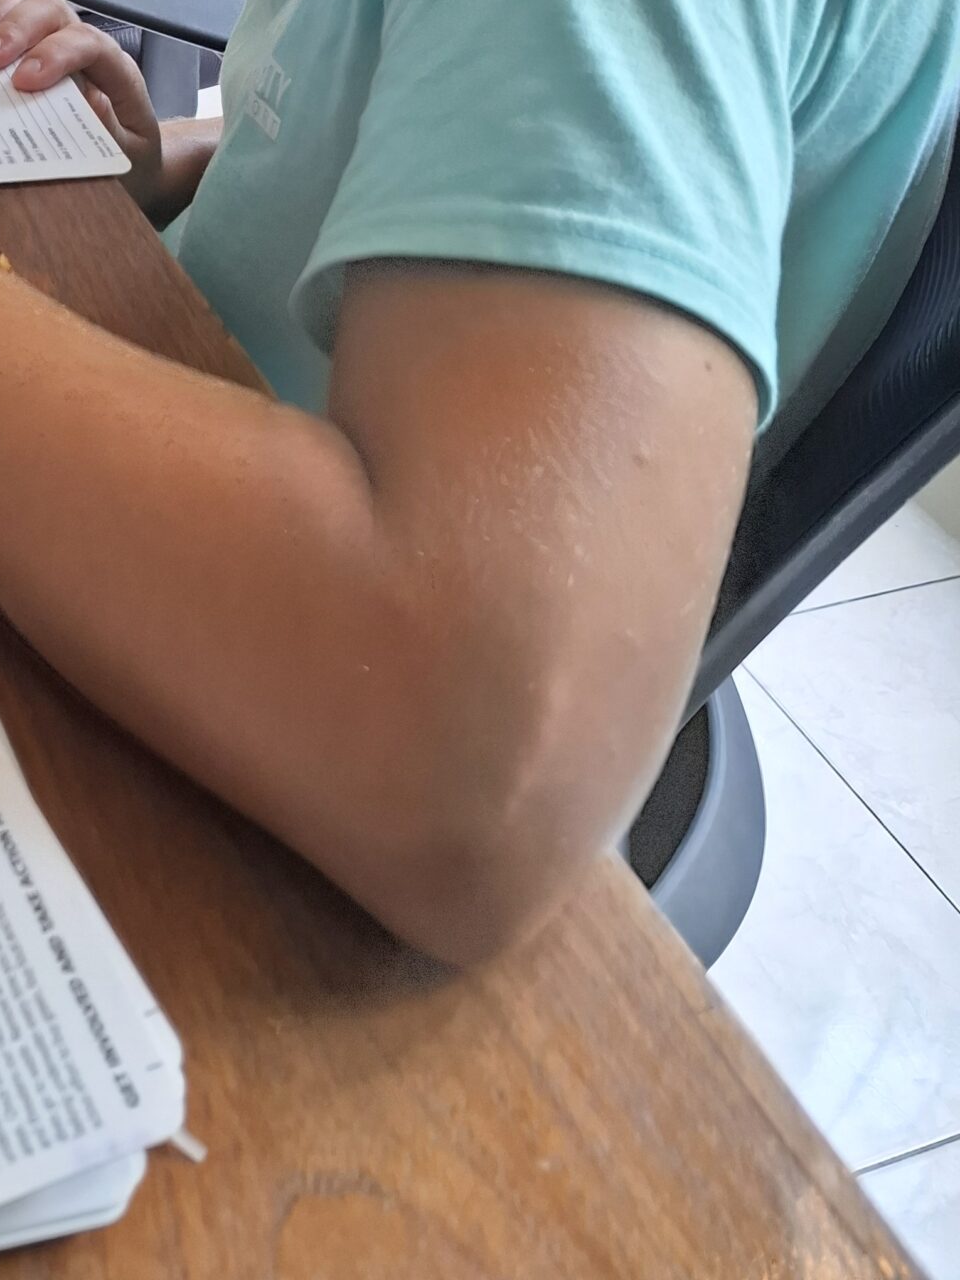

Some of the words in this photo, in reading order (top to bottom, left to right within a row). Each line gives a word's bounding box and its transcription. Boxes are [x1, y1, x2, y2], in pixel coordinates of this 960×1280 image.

[27, 892, 53, 932] TAKE
[49, 936, 74, 973] AND
[69, 978, 119, 1067] INVOLVED
